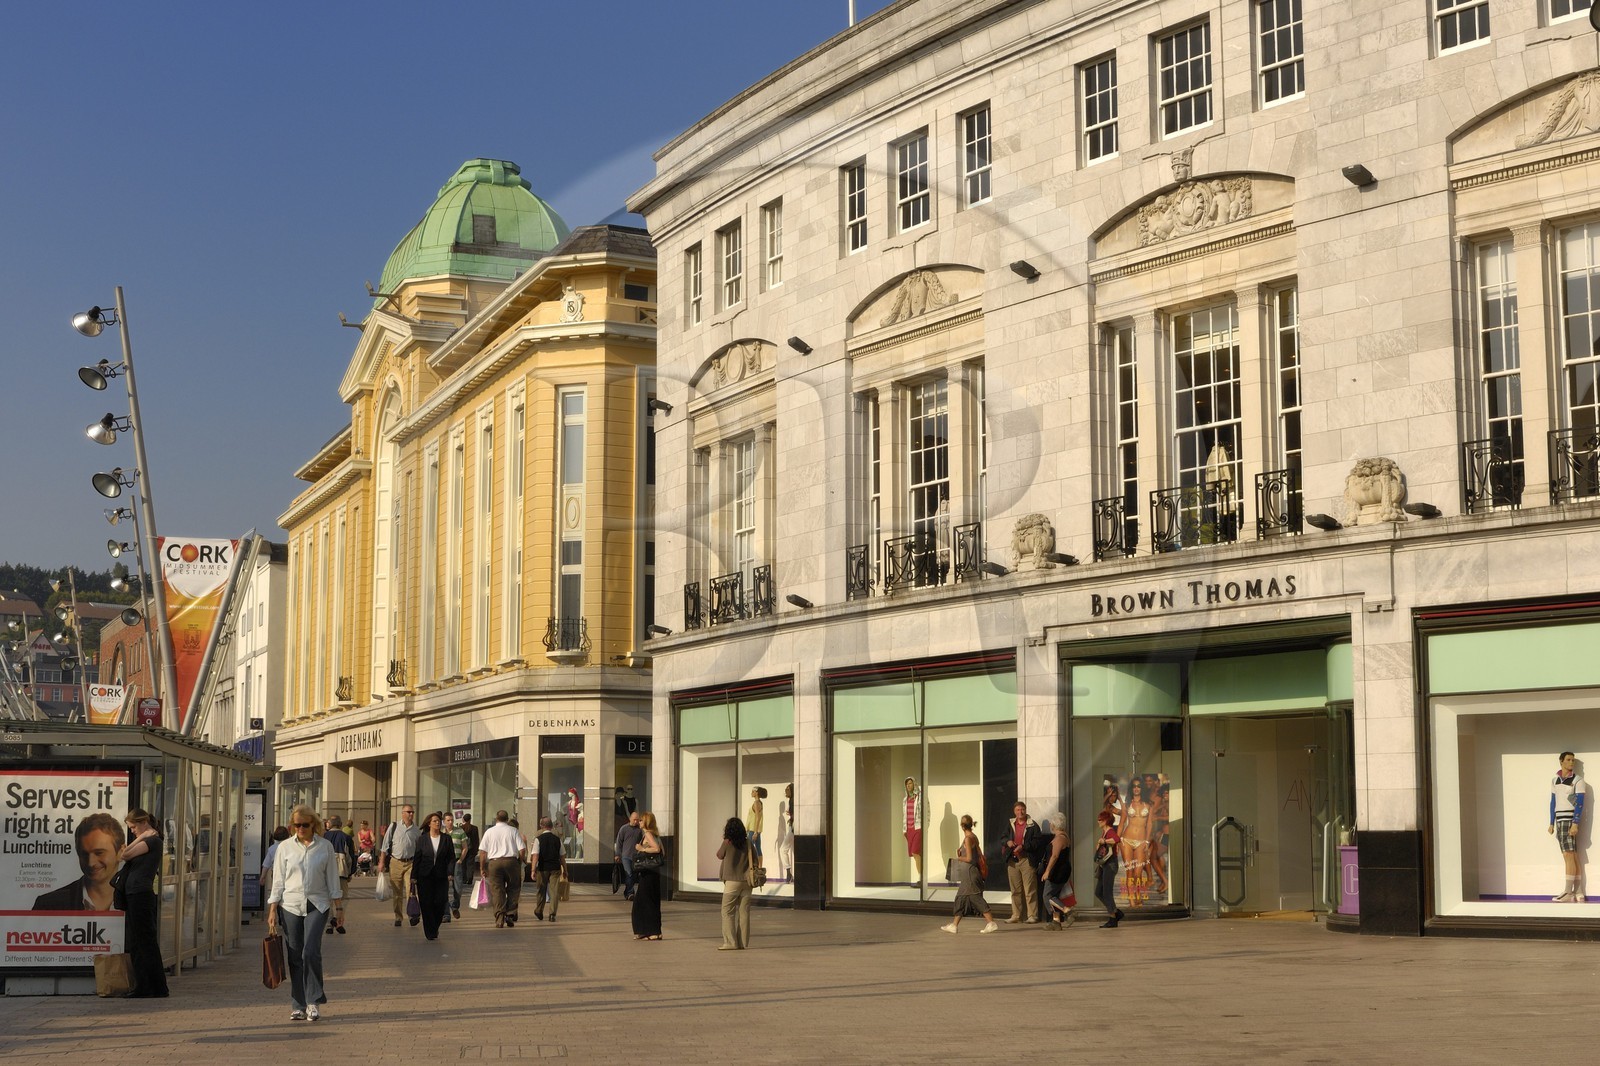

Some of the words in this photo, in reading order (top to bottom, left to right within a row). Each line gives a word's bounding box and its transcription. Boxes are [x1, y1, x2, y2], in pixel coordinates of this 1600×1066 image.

[166, 543, 229, 564] CORK
[165, 563, 228, 571] MIDSUMMER
[1091, 593, 1174, 617] BROWN
[1187, 575, 1297, 606] THOMAS
[91, 687, 122, 698] CORK
[144, 707, 156, 716] Bus
[528, 719, 596, 728] DEBENHAMS
[340, 729, 382, 754] DEBENHAMS
[454, 749, 480, 761] DEBENHAMS
[5, 782, 91, 810] Serves
[97, 783, 113, 810] it
[4, 812, 50, 839] right
[54, 815, 74, 835] at
[3, 840, 72, 855] Lunchtime
